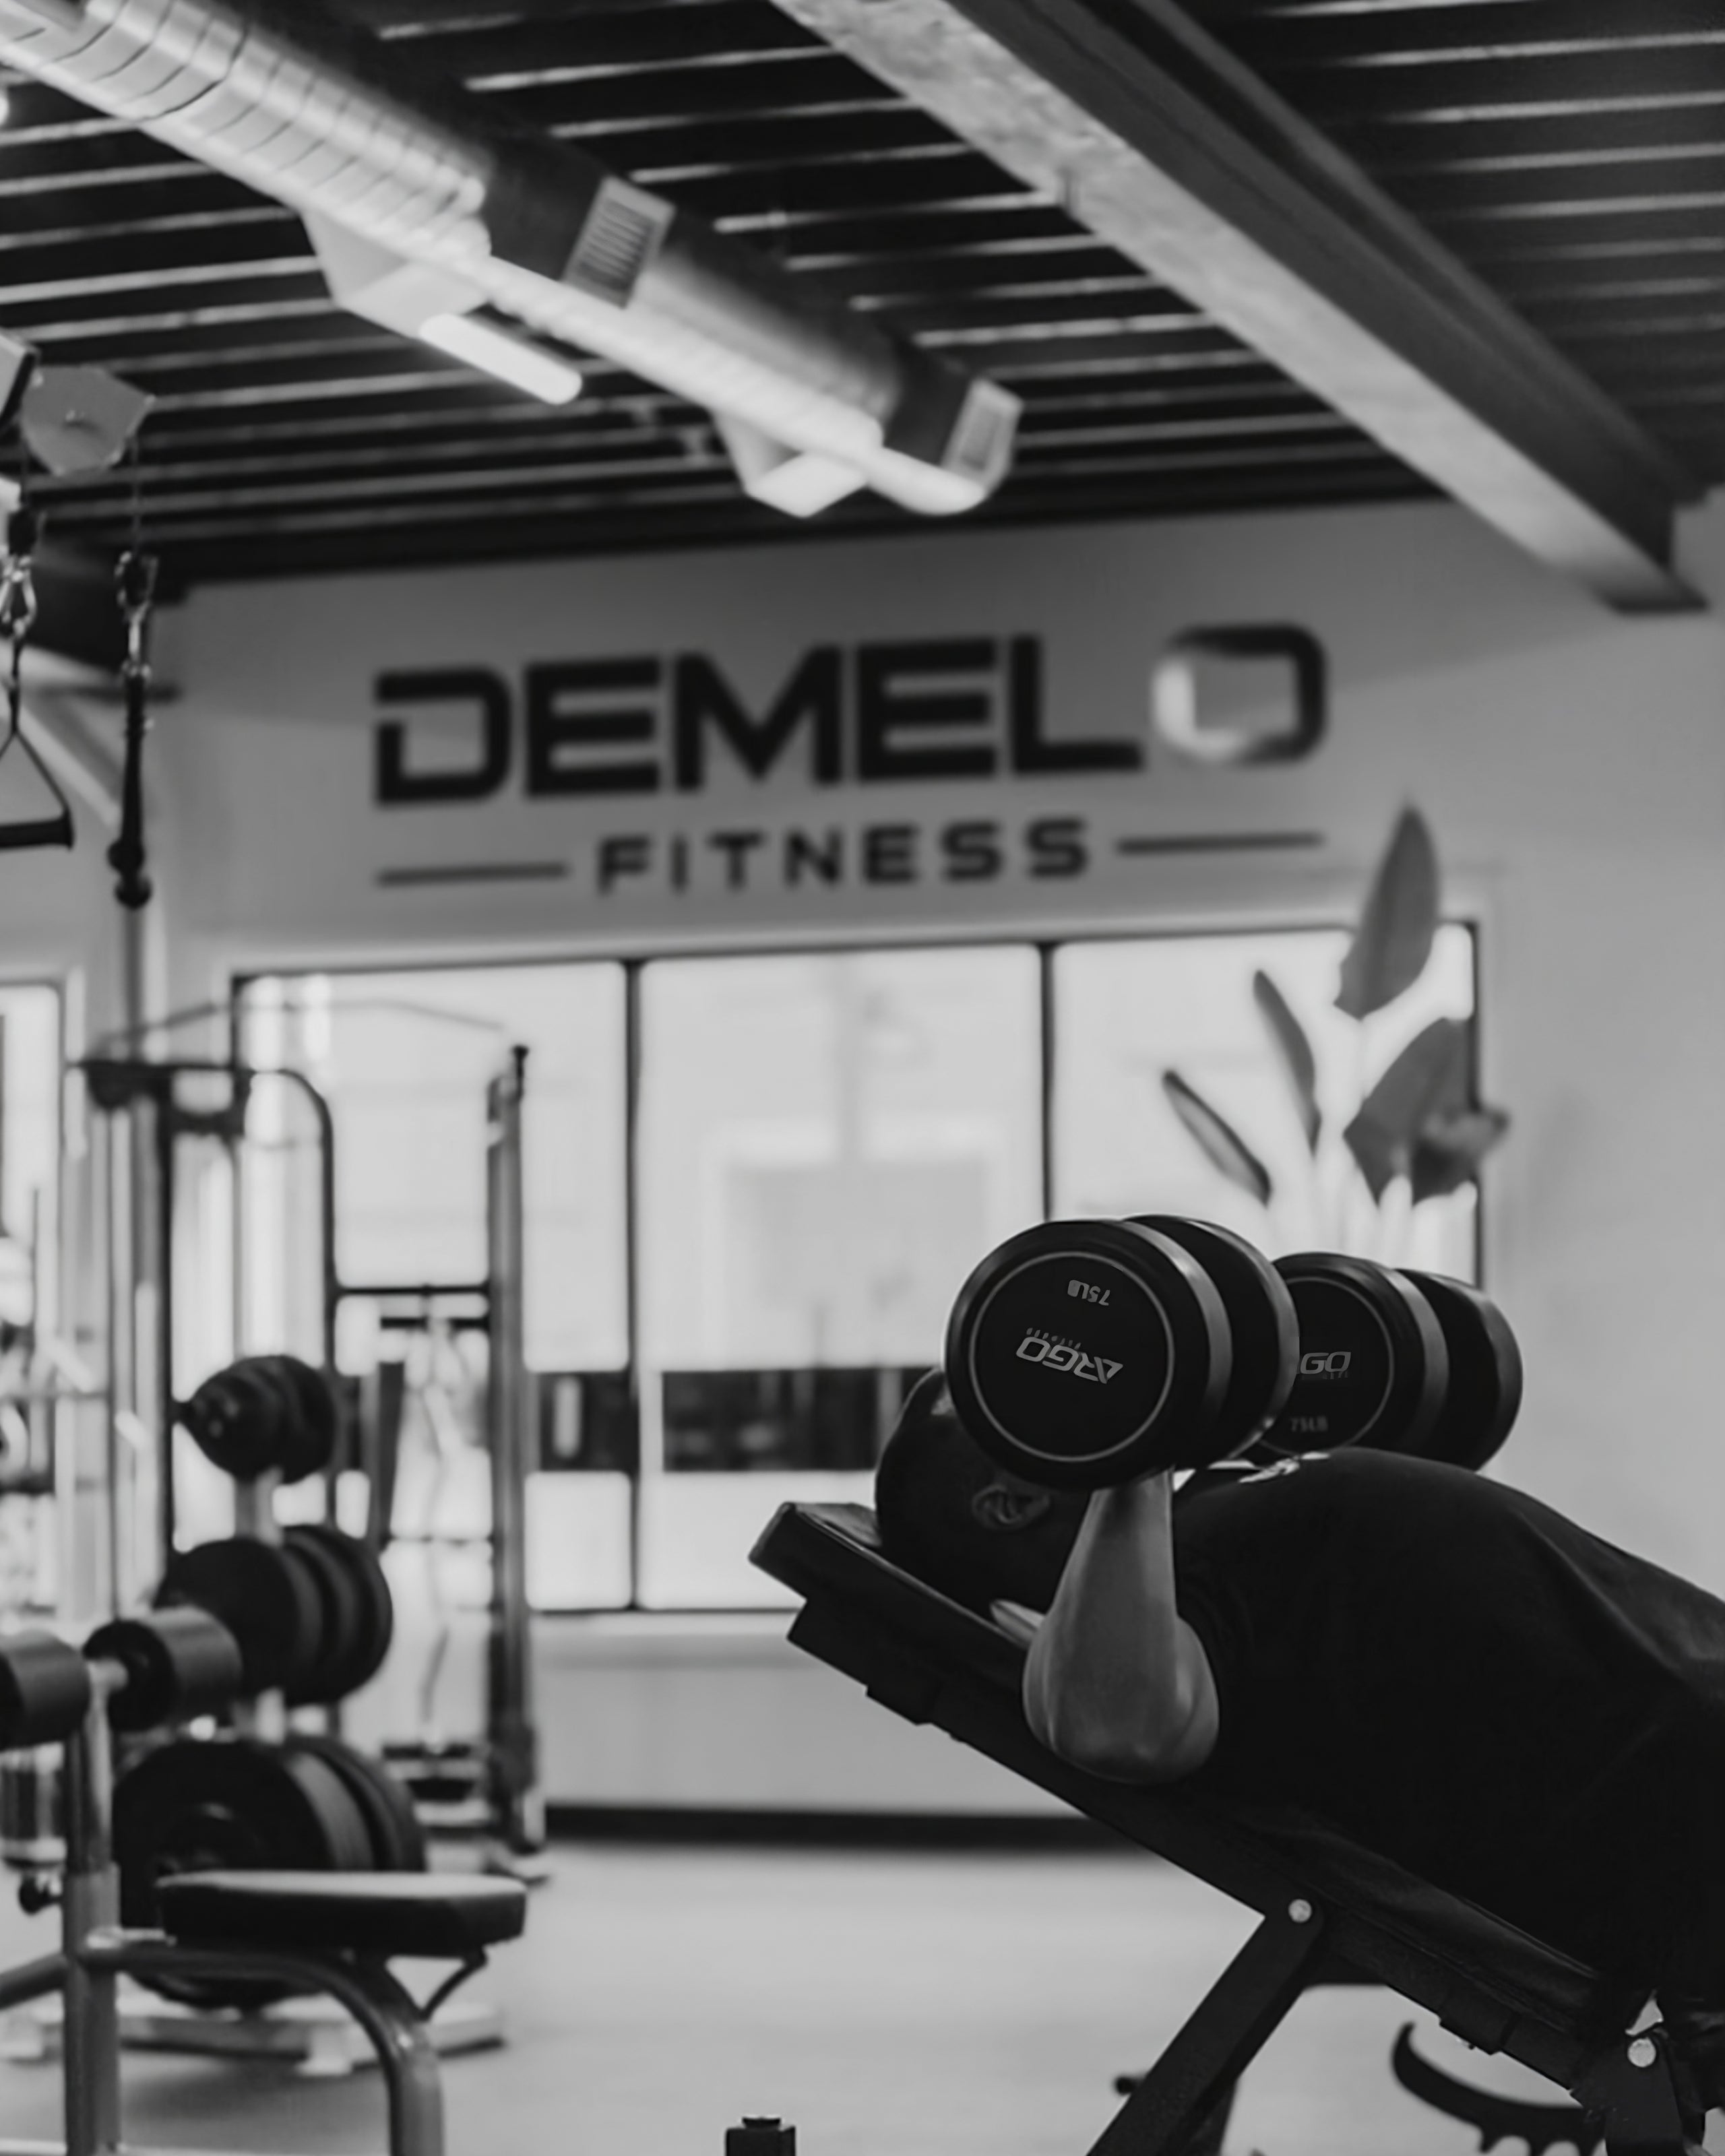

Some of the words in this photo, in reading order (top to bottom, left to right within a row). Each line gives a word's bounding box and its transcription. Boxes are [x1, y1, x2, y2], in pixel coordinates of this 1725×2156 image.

[375, 623, 1329, 806] DEMELO
[597, 818, 1090, 895] FITNESS
[1067, 1279, 1110, 1306] 75LB
[1016, 1336, 1124, 1384] ARGO
[1298, 1351, 1352, 1374] GO
